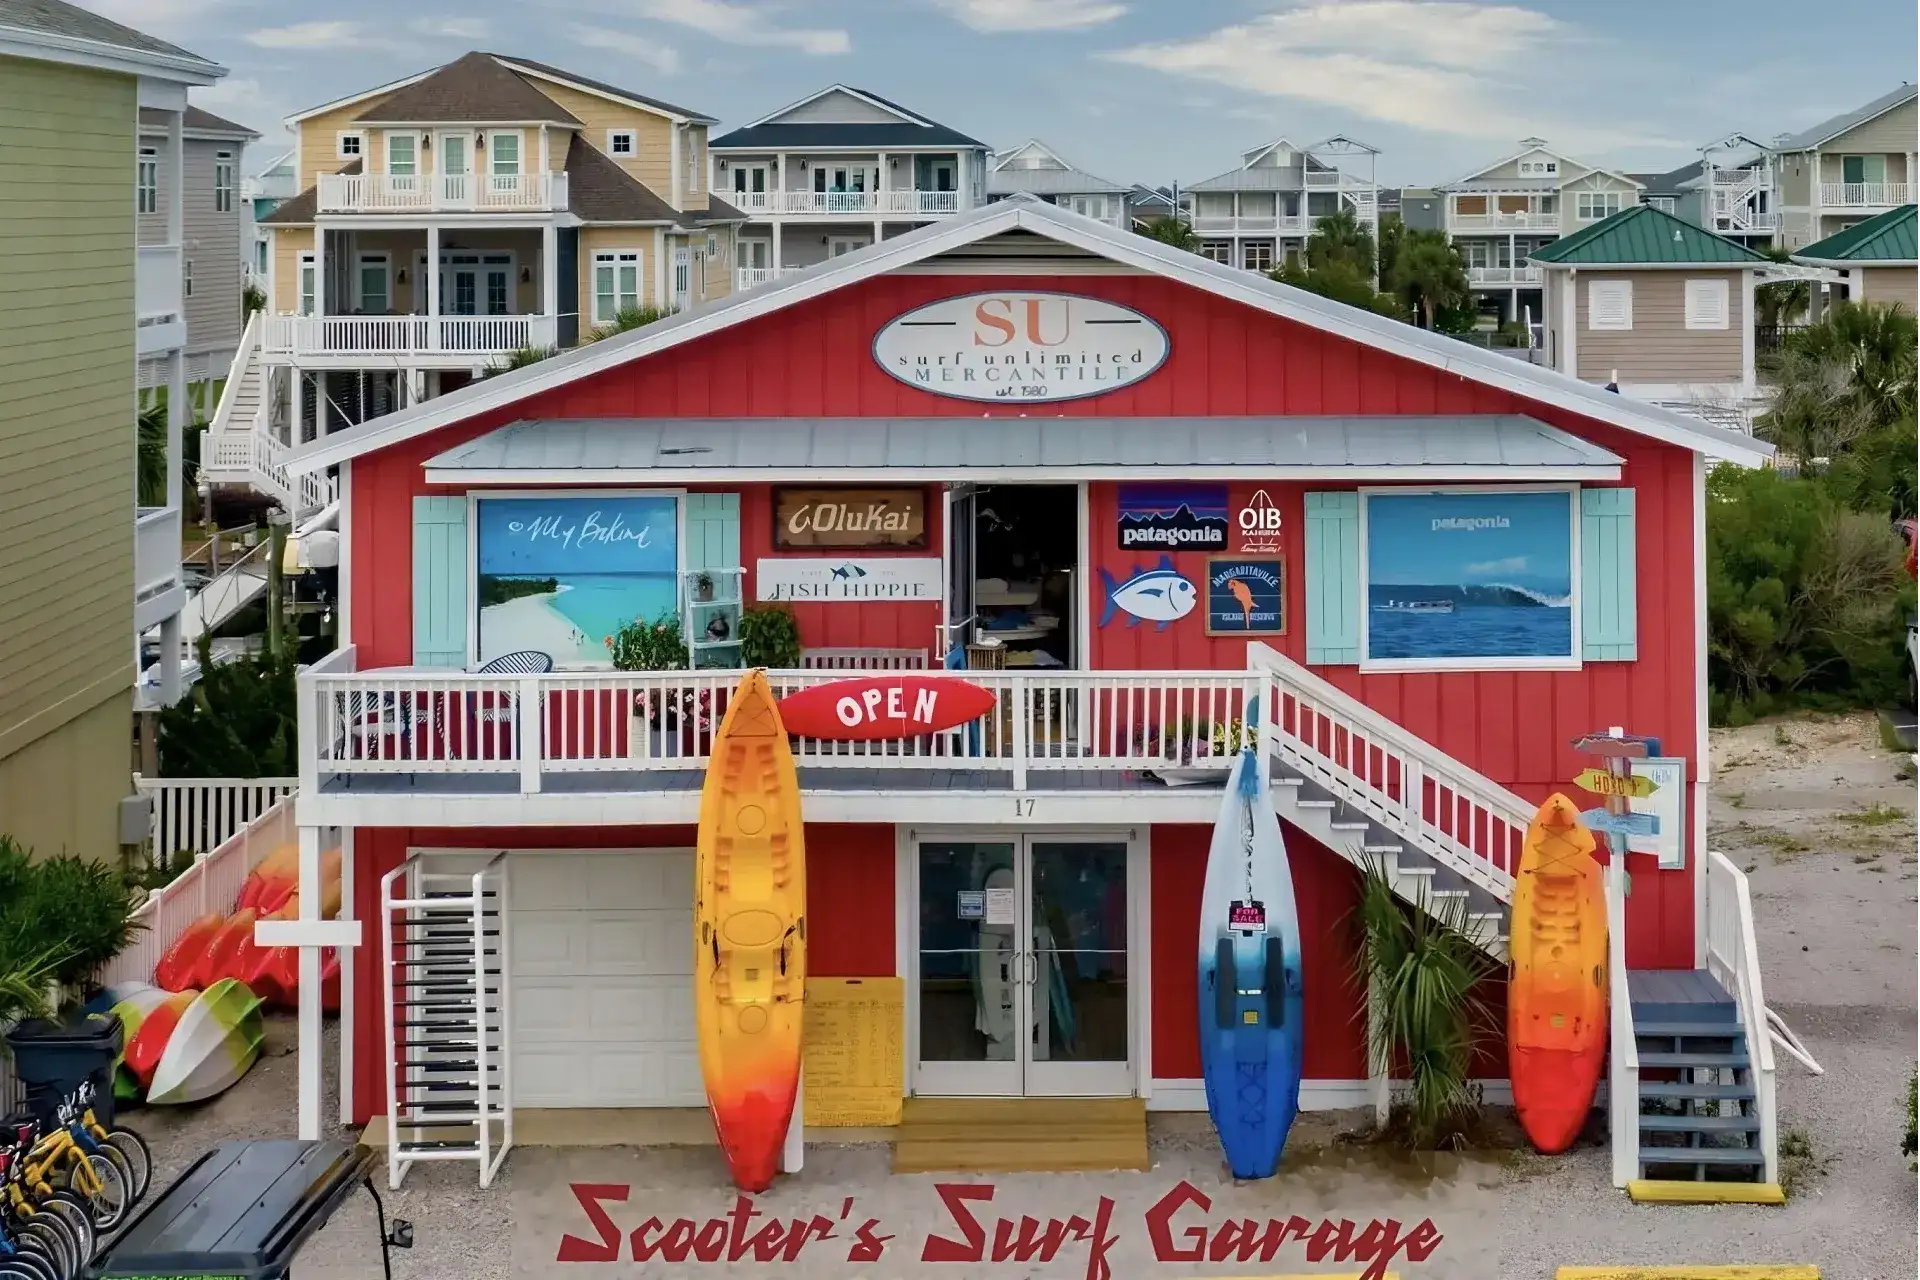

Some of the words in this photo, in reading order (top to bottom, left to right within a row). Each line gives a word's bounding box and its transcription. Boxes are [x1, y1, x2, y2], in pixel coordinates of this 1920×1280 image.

[974, 298, 1072, 347] SU
[899, 351, 963, 366] surf
[984, 349, 1143, 365] unlimited
[811, 503, 912, 533] OluKai
[1238, 507, 1282, 530] OIB
[1431, 515, 1511, 531] patagonia
[527, 515, 576, 550] My
[1123, 525, 1223, 546] patagonia
[1212, 565, 1279, 588] MARGARITAVILLE
[775, 583, 829, 597] FISH
[843, 583, 927, 597] HIPPIE
[836, 687, 938, 727] OPEN
[1014, 798, 1036, 817] 17
